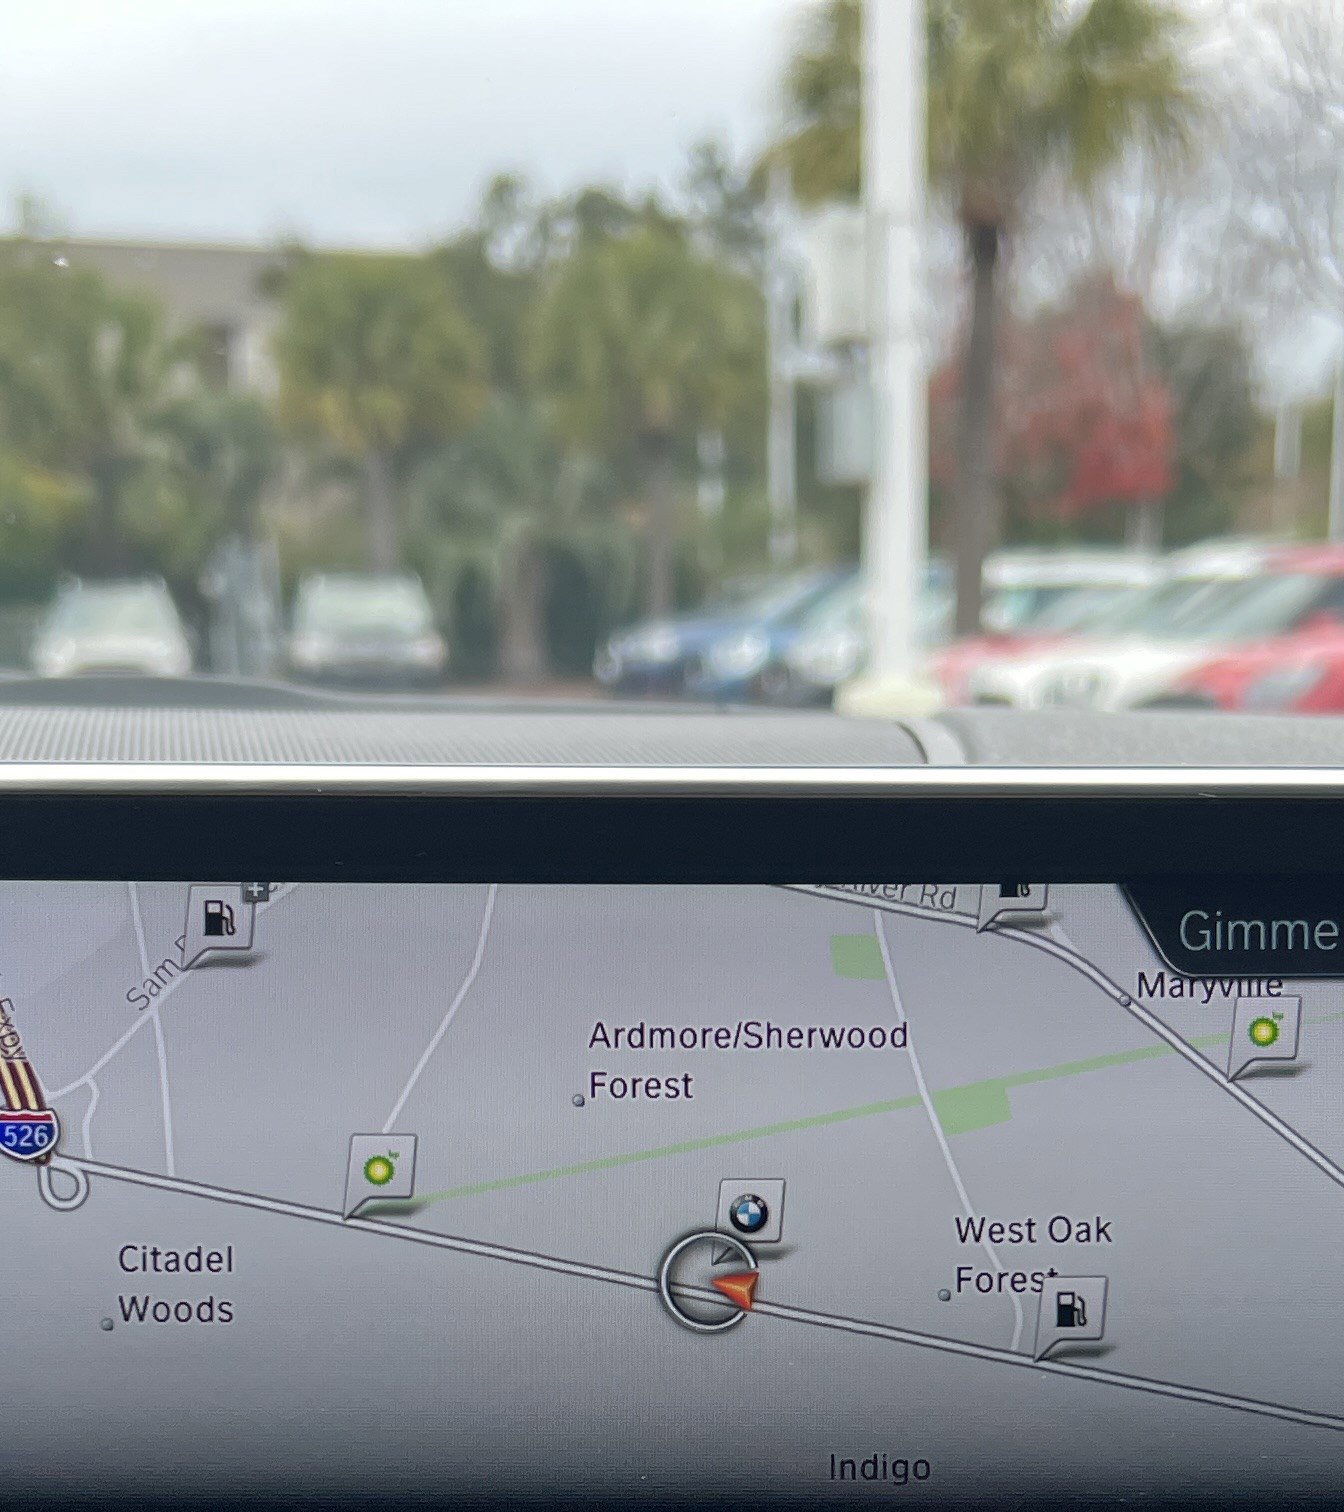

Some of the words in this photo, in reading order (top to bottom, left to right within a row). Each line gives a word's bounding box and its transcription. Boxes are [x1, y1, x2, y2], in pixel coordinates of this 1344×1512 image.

[919, 885, 957, 911] Rd
[1179, 910, 1340, 950] Gimme
[126, 958, 183, 1010] Sam
[588, 1021, 908, 1049] Ardmore/Sherwood
[590, 1071, 694, 1099] Forest
[4, 1125, 49, 1147] 526
[955, 1216, 1037, 1244] West
[1048, 1215, 1113, 1243] Oak
[119, 1244, 232, 1273] Citadel
[118, 1295, 234, 1323] Woods
[830, 1453, 931, 1485] Indigo
